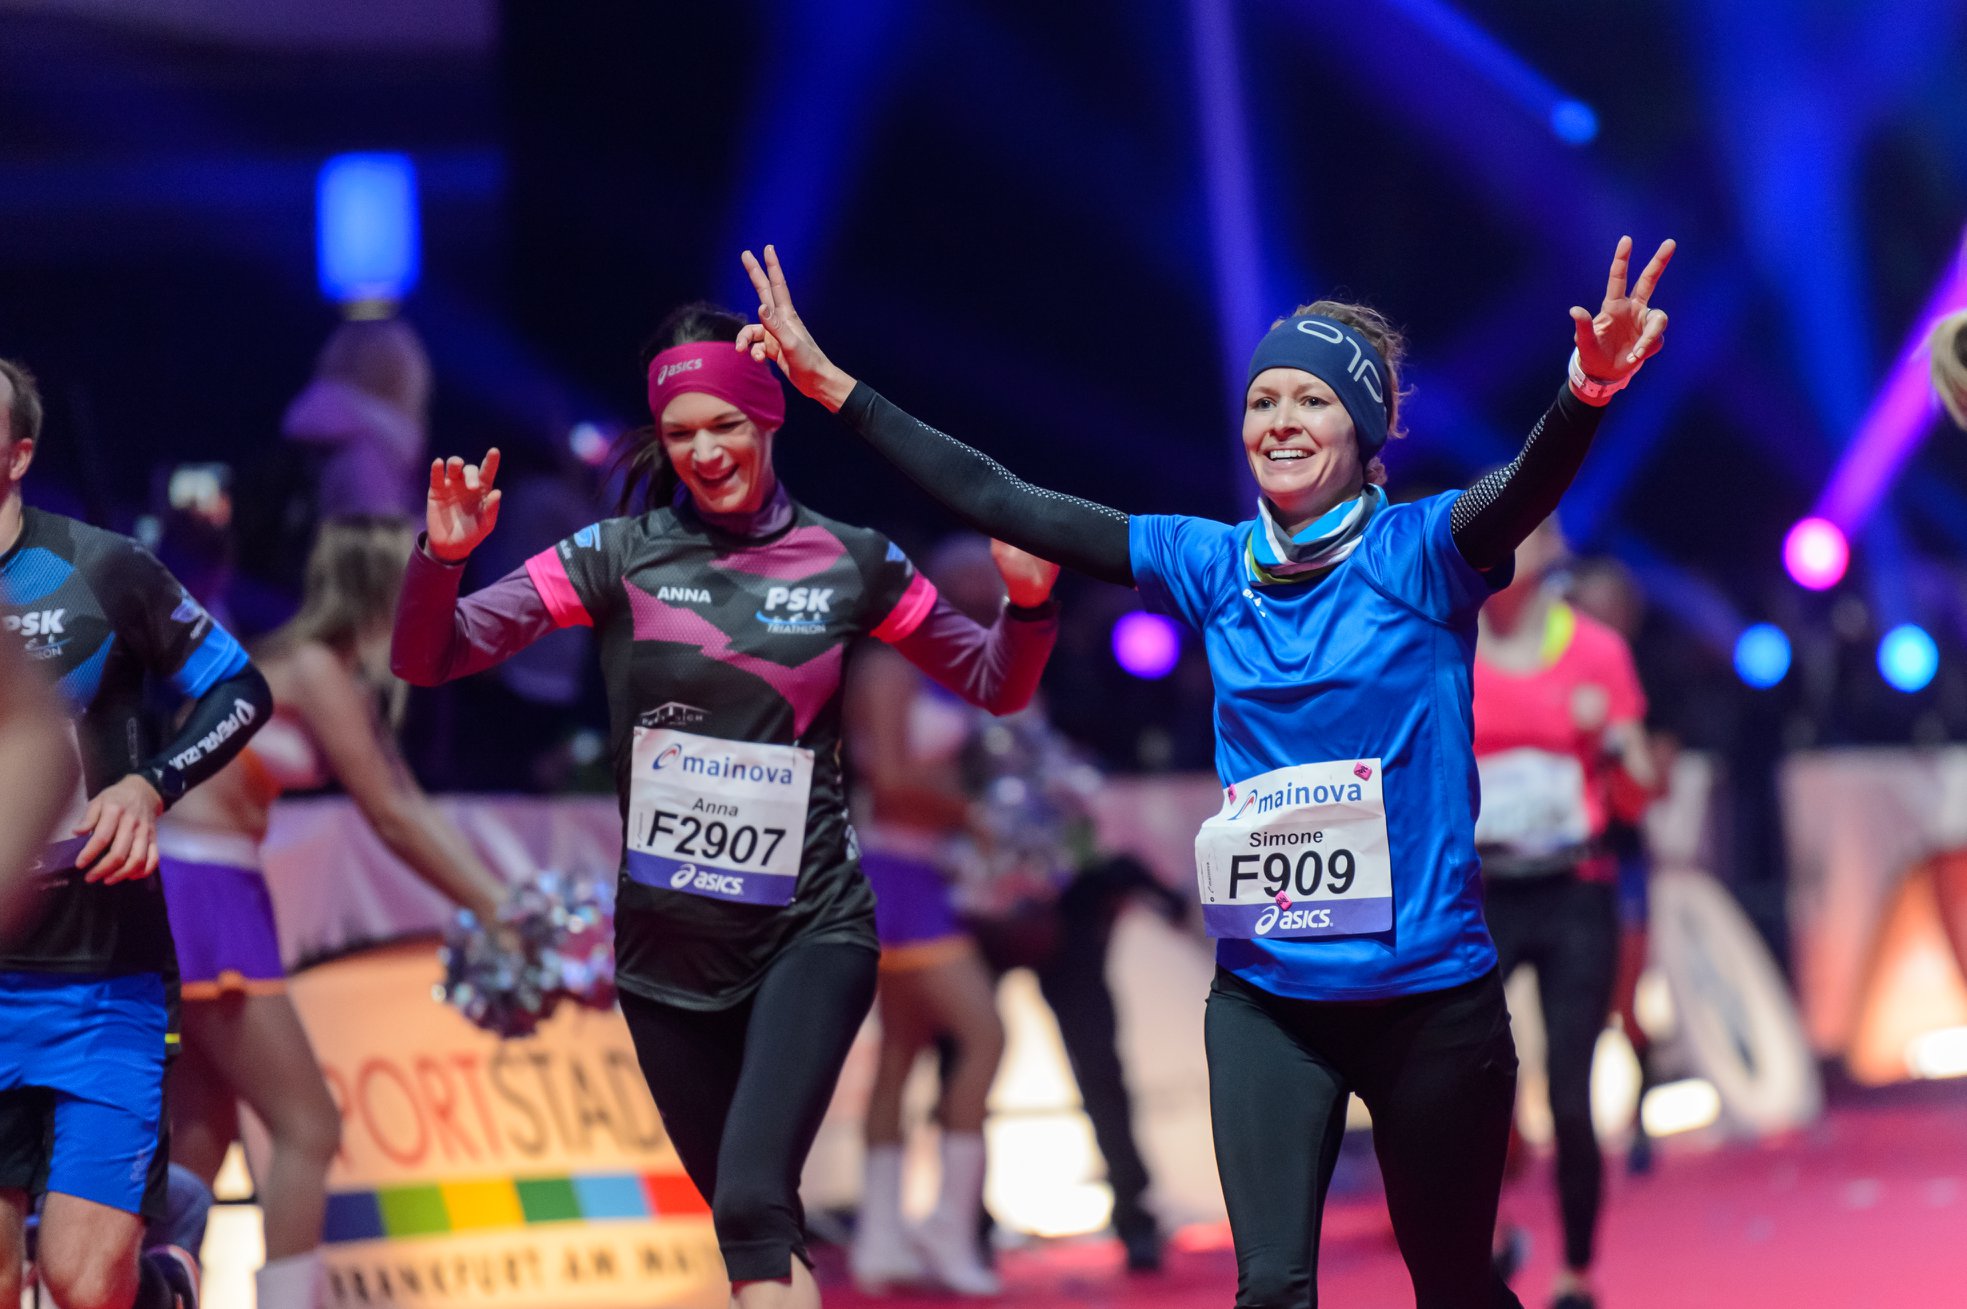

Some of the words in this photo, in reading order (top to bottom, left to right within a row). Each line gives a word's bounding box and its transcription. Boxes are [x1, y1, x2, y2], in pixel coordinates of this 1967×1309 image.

[657, 586, 712, 604] ANNA
[765, 586, 834, 613] PSK
[767, 622, 827, 635] TRIATHLON
[682, 753, 793, 786] mainova
[691, 797, 739, 818] Anna
[1257, 781, 1363, 814] mainova
[645, 808, 787, 868] F2907
[1248, 829, 1324, 848] Simone
[1228, 848, 1356, 900] F909
